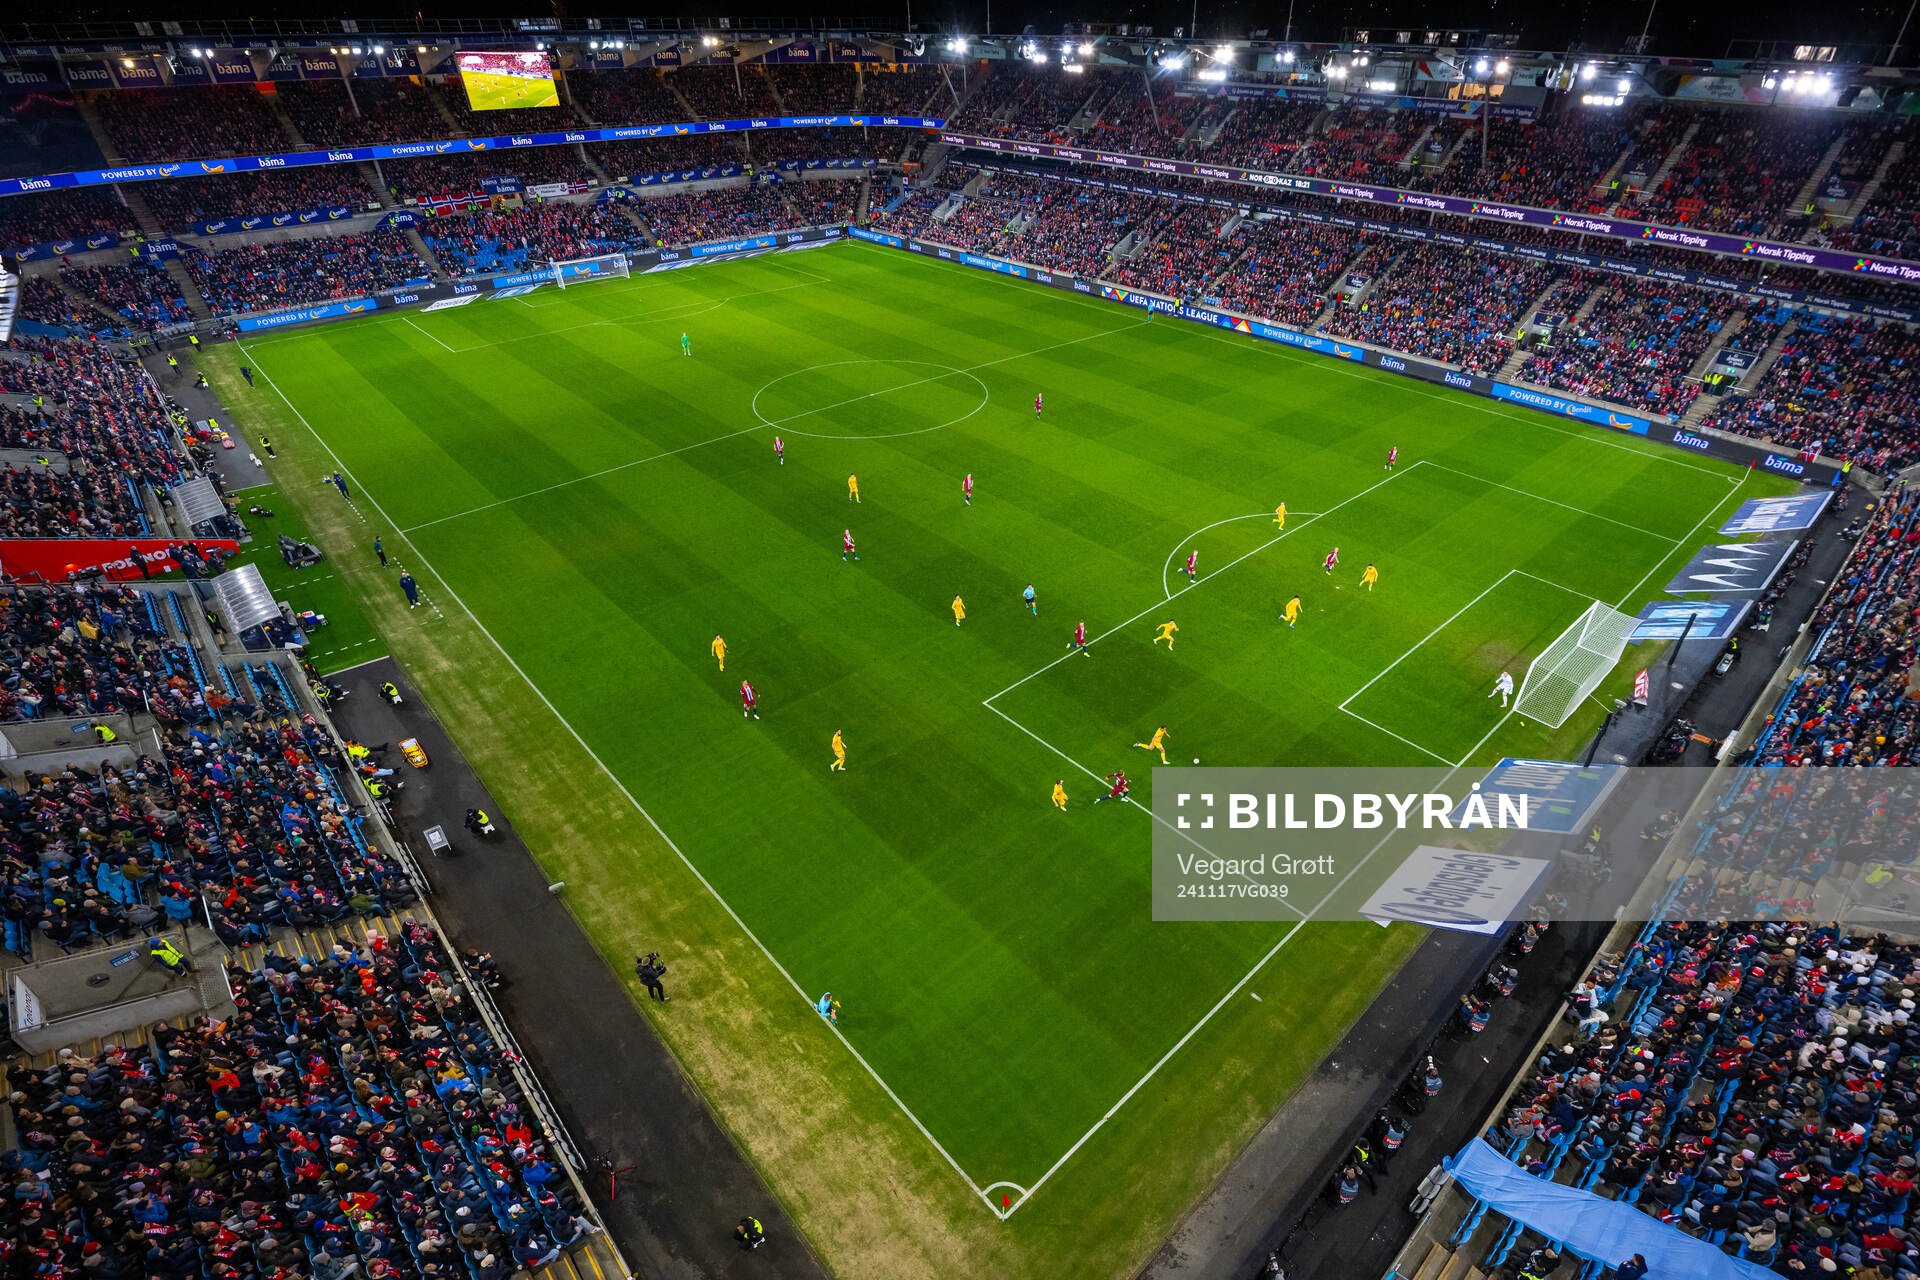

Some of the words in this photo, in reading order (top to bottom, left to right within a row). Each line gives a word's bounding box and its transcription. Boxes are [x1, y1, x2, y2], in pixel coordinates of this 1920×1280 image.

[597, 51, 619, 61] bama
[788, 47, 810, 57] bama
[216, 62, 251, 75] bama
[304, 59, 337, 71] bama
[67, 67, 110, 81] bama
[120, 66, 158, 79] bama
[709, 122, 725, 131] bama
[752, 119, 767, 127] bama
[883, 116, 899, 125] bama
[923, 117, 936, 127] bama
[566, 132, 585, 141] bama
[615, 129, 641, 137] POWERED
[512, 137, 533, 145] bama
[392, 146, 425, 154] POWERED
[258, 157, 285, 167] bama
[328, 152, 353, 161] bama
[1113, 156, 1127, 165] Tipping
[1161, 163, 1176, 172] Tipping
[1200, 167, 1213, 175] Norsk
[1214, 169, 1229, 178] Tipping
[101, 171, 145, 180] POWERED
[146, 168, 157, 176] BY
[20, 179, 52, 192] bama
[1249, 173, 1264, 182] NOR
[1279, 177, 1293, 187] KAZ
[1295, 180, 1310, 188] 18:21
[1339, 186, 1355, 195] Norsk
[1354, 188, 1374, 199] Tipping
[1407, 195, 1425, 204] Norsk
[1424, 198, 1446, 209] Tipping
[391, 212, 413, 224] ama
[1481, 206, 1501, 216] Norsk
[1500, 208, 1525, 220] Tipping
[1564, 217, 1585, 228] Norsk
[1585, 220, 1611, 233] Tipping
[787, 234, 804, 243] bama
[825, 228, 840, 237] bama
[1655, 230, 1678, 242] Norsk
[1678, 233, 1708, 247] Tipping
[147, 240, 178, 254] bama
[702, 244, 726, 254] POWERED
[727, 243, 735, 251] BY
[909, 242, 922, 252] bama
[938, 248, 952, 258] bama
[660, 250, 679, 261] bama
[1757, 245, 1783, 257] Norsk
[1783, 249, 1816, 263] Tipping
[1869, 262, 1899, 275] Norsk
[1037, 272, 1052, 283] bama
[454, 284, 478, 294] bama
[1074, 281, 1090, 292] bama
[394, 293, 419, 304] bama
[1129, 294, 1148, 306] UEFA
[1186, 308, 1219, 323] LEAGUE
[256, 313, 297, 327] POWERED
[298, 312, 308, 320] BY
[1263, 327, 1295, 341] POWERED
[1295, 334, 1304, 343] BY
[1380, 355, 1406, 371] bama
[1444, 371, 1472, 388] bama
[1509, 389, 1552, 407] POWERED
[1553, 399, 1566, 410] BY
[1572, 404, 1593, 414] Bendit
[1673, 431, 1710, 449] bama
[1765, 454, 1805, 474] bama
[1635, 671, 1647, 698] VG
[1402, 853, 1521, 910] Gjensidige
[24, 989, 33, 1027] Telenor
